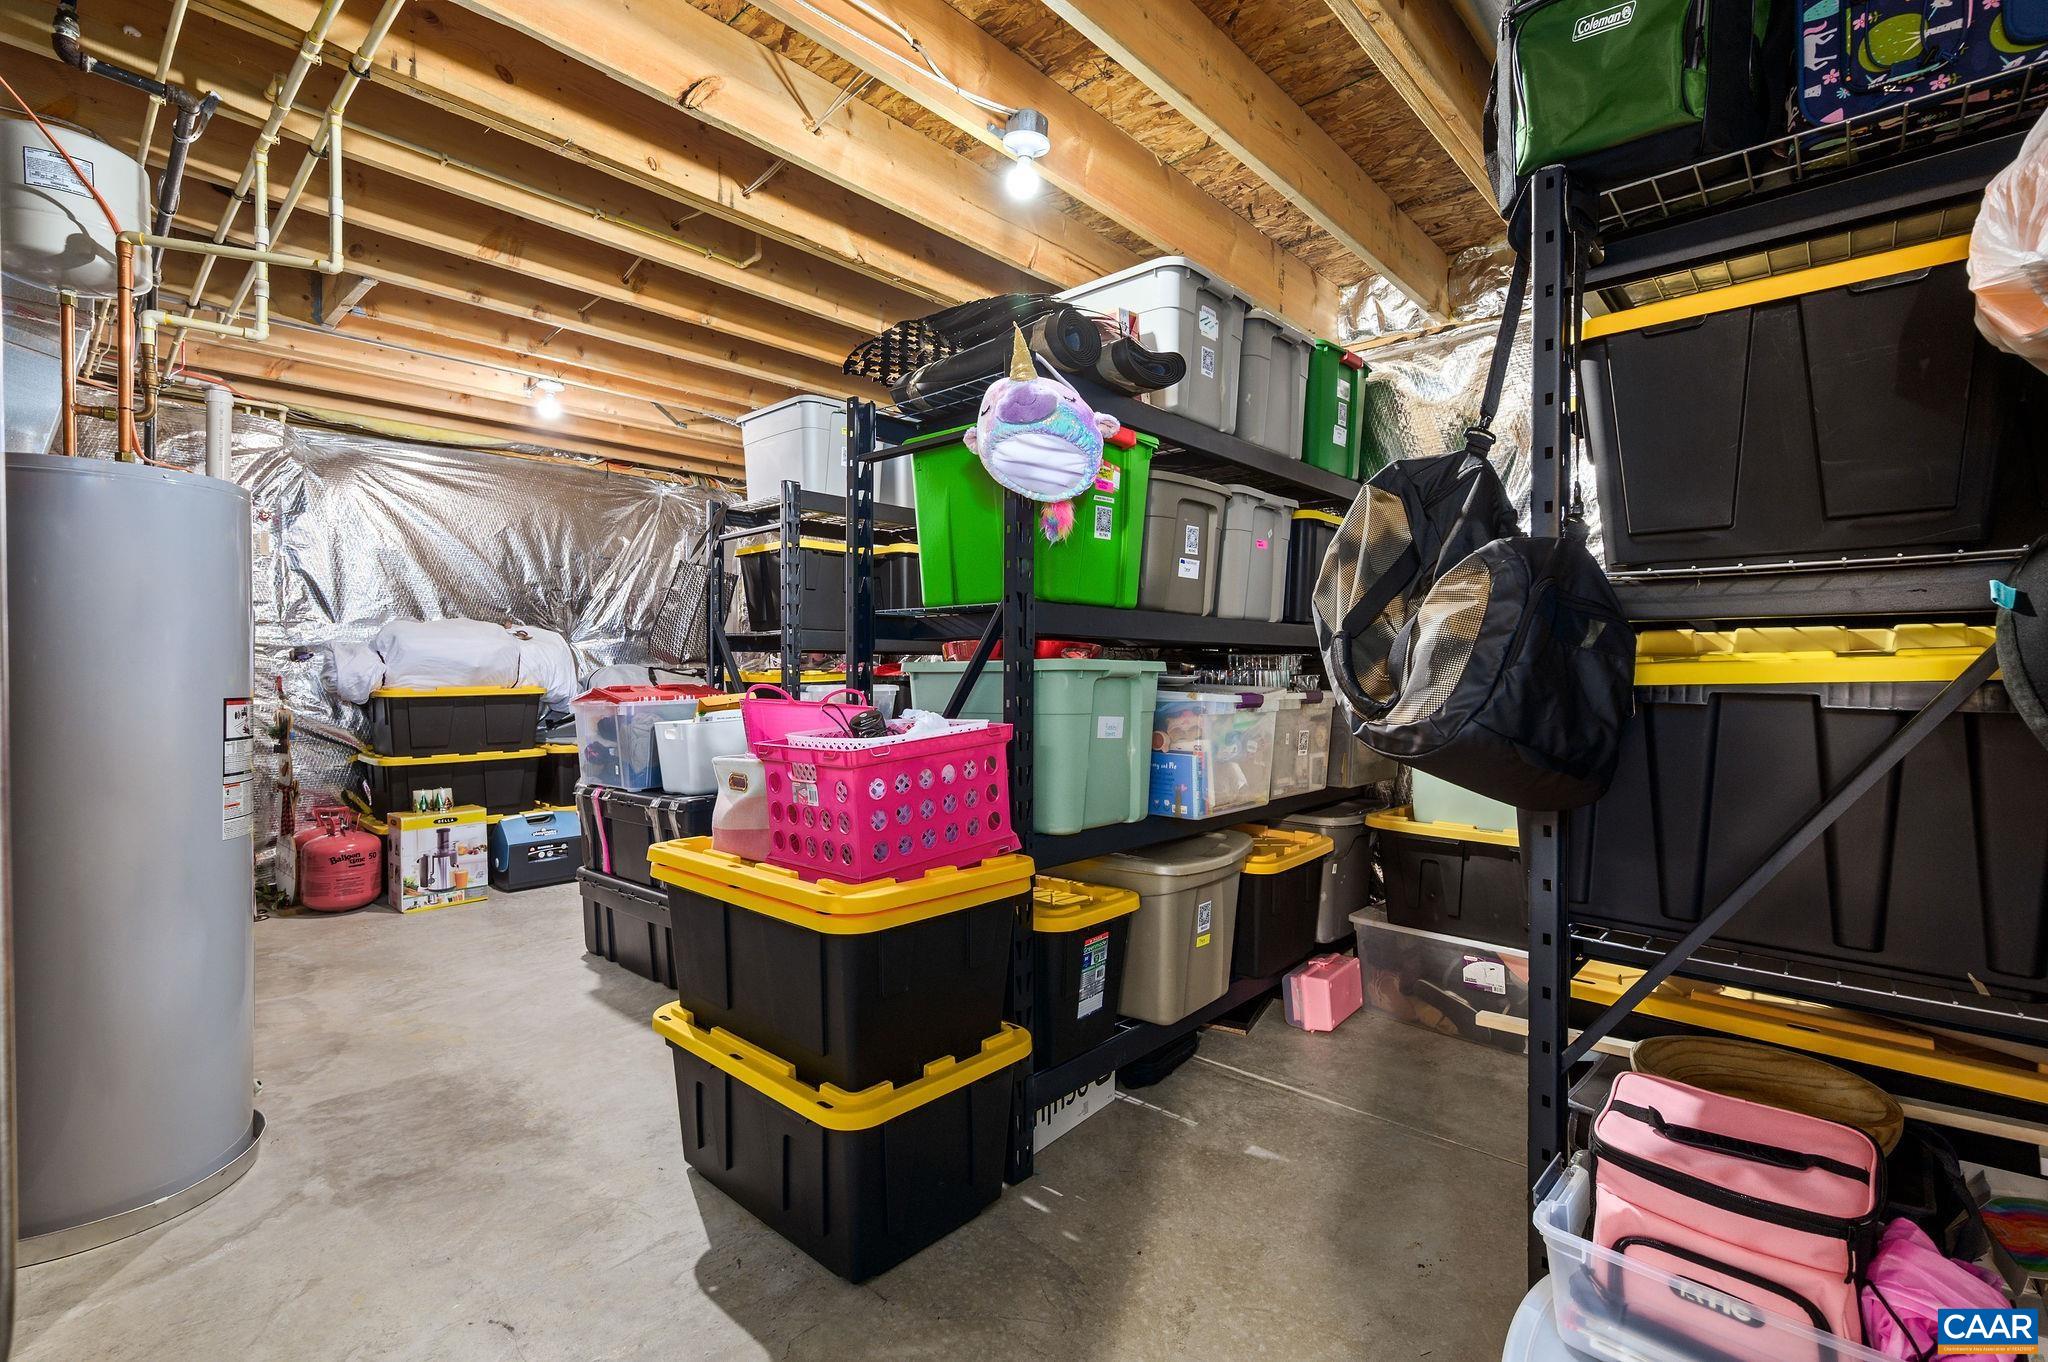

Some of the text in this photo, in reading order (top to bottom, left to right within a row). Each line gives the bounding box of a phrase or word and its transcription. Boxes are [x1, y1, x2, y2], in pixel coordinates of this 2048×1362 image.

[1577, 11, 1622, 35] Coleman
[328, 851, 377, 865] Balloon 50
